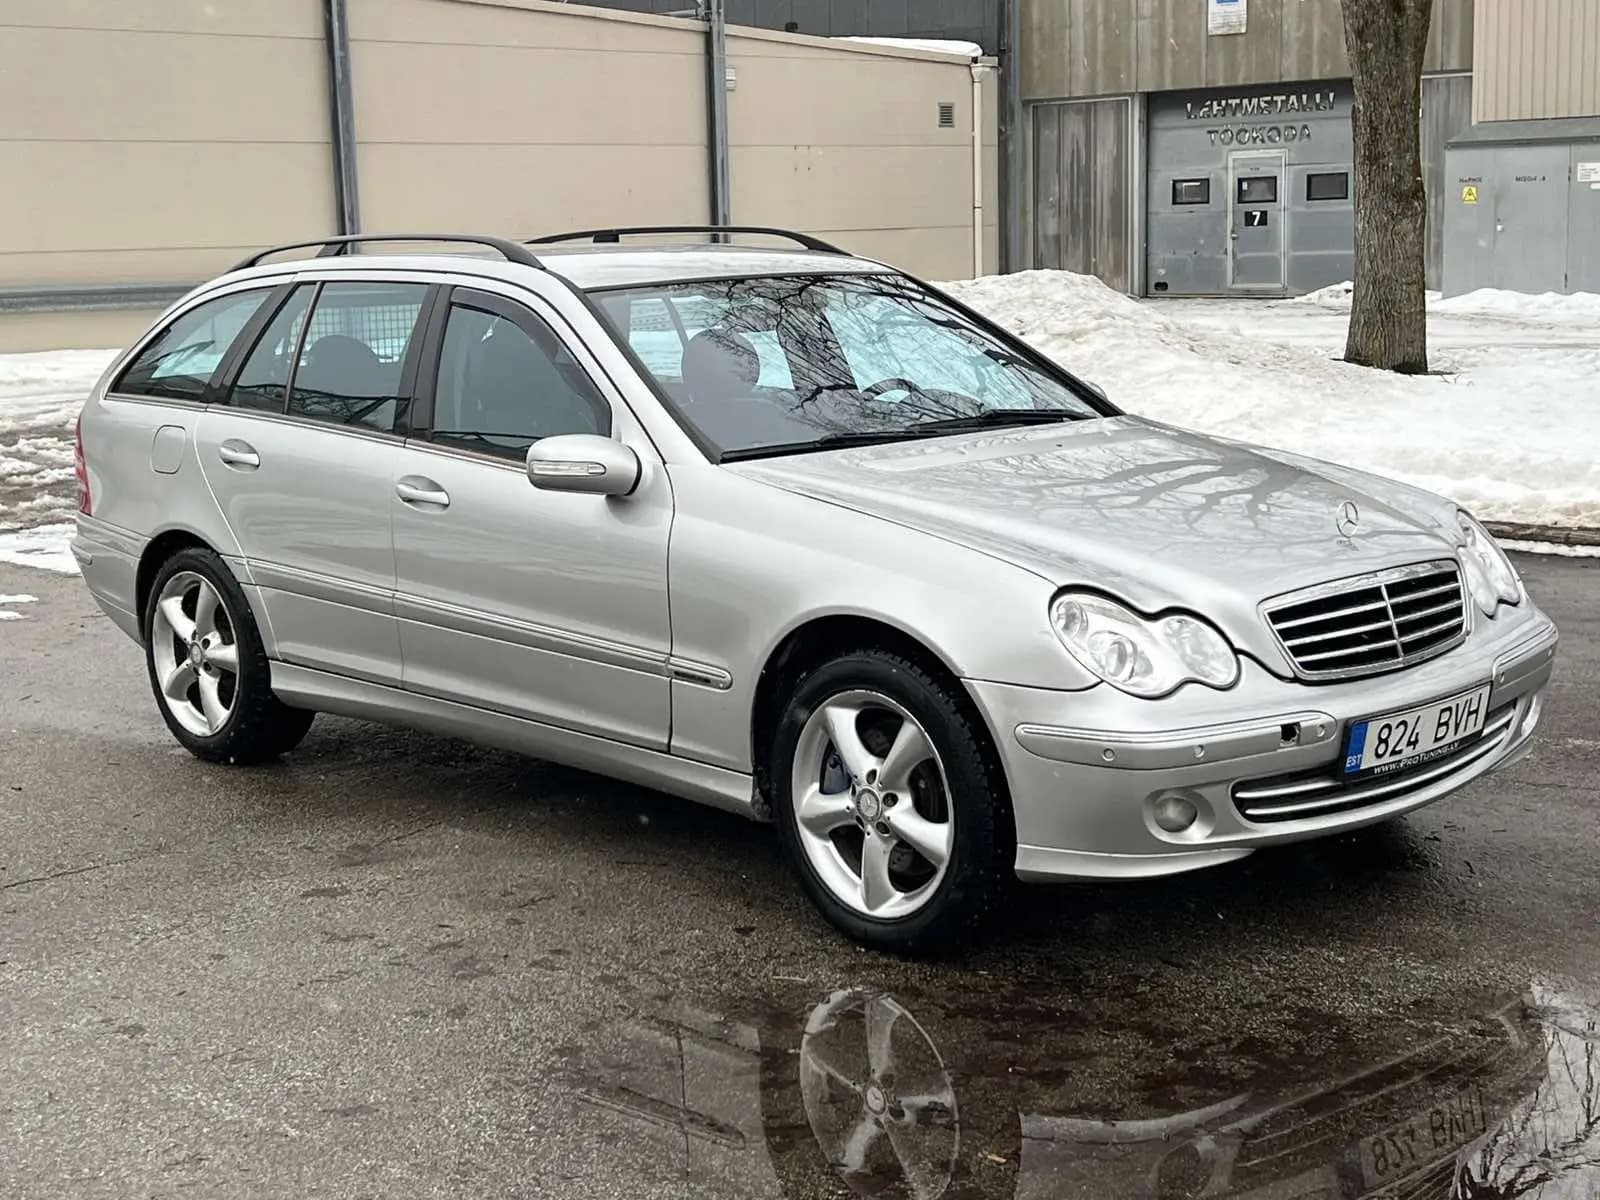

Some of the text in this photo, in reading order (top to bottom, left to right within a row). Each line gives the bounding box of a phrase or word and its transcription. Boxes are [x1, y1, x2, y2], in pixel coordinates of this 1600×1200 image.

[1185, 92, 1336, 120] LEHTMETALLI
[1251, 211, 1262, 226] 7
[1374, 692, 1482, 759] 824 BVH
[1345, 754, 1361, 768] EST
